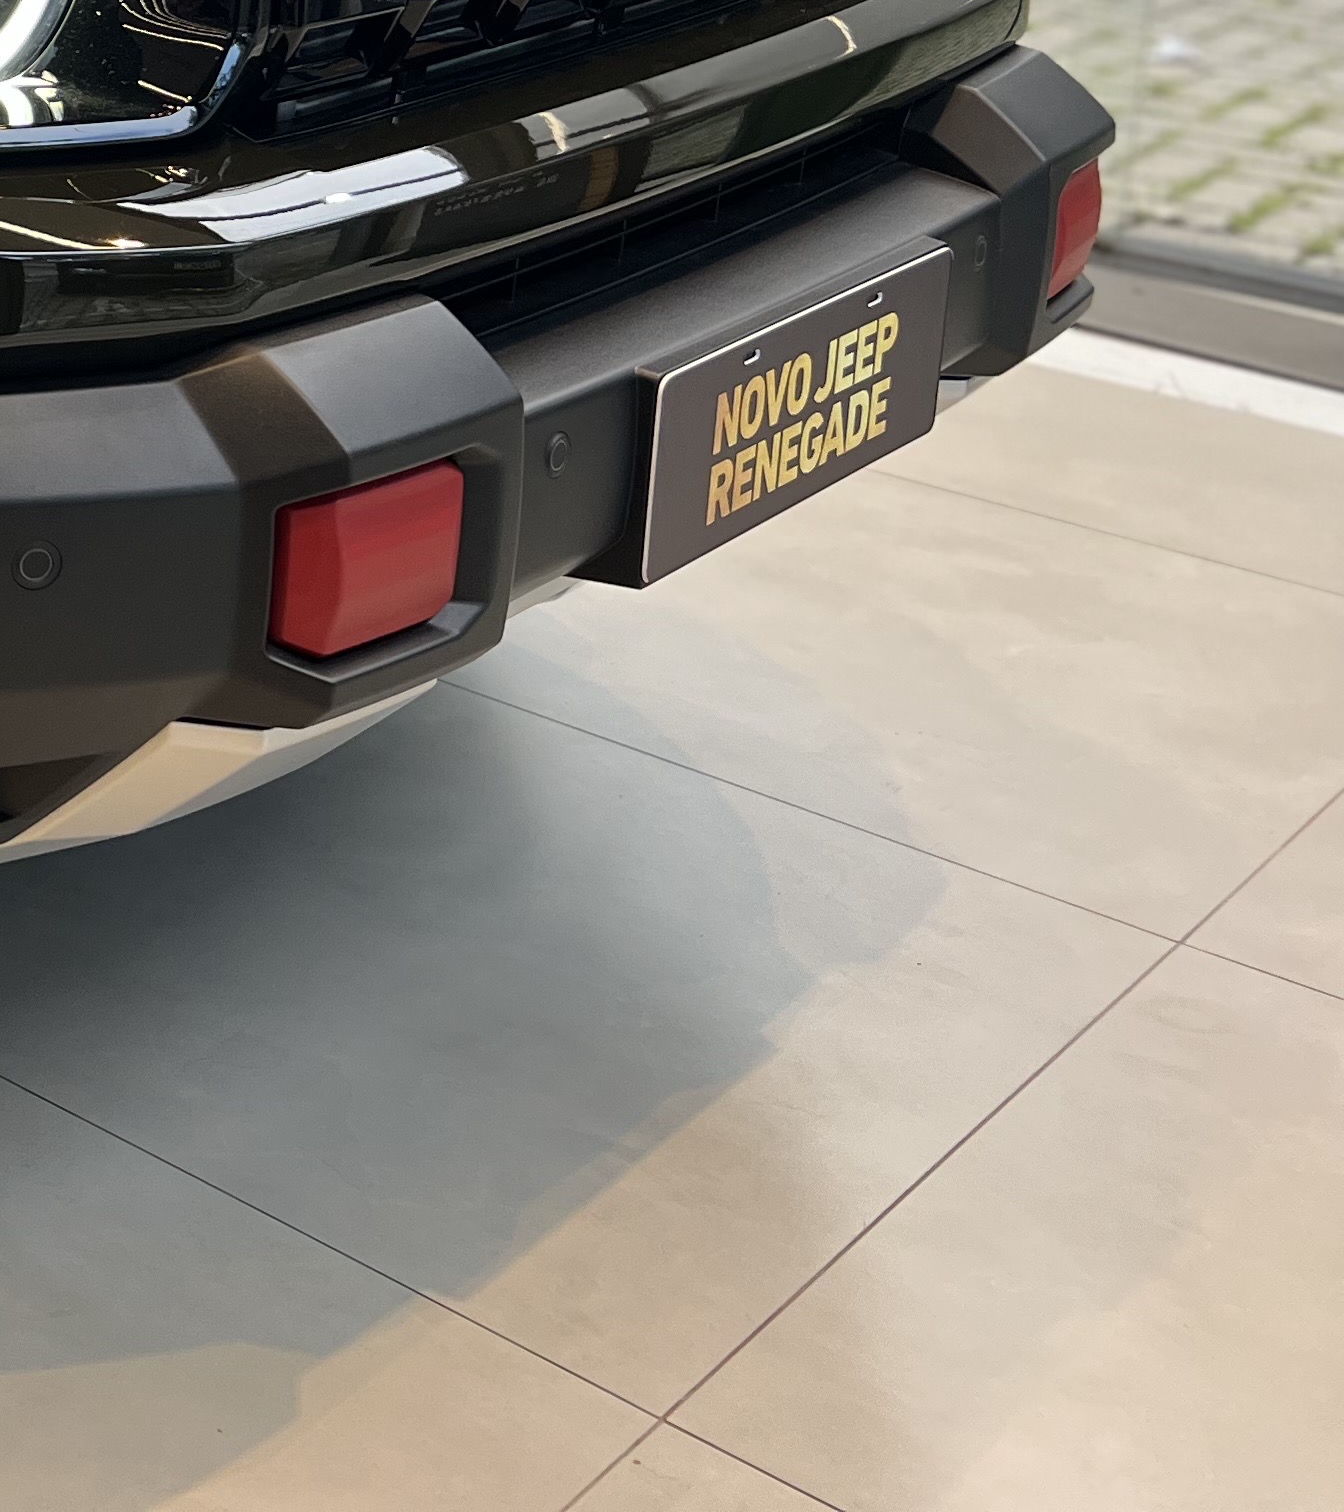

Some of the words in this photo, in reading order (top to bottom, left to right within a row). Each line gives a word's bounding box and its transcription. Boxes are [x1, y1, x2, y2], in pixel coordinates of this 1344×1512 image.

[705, 376, 893, 527] RENEGADE
[712, 352, 813, 455] NOVO
[813, 311, 900, 404] JEEP
